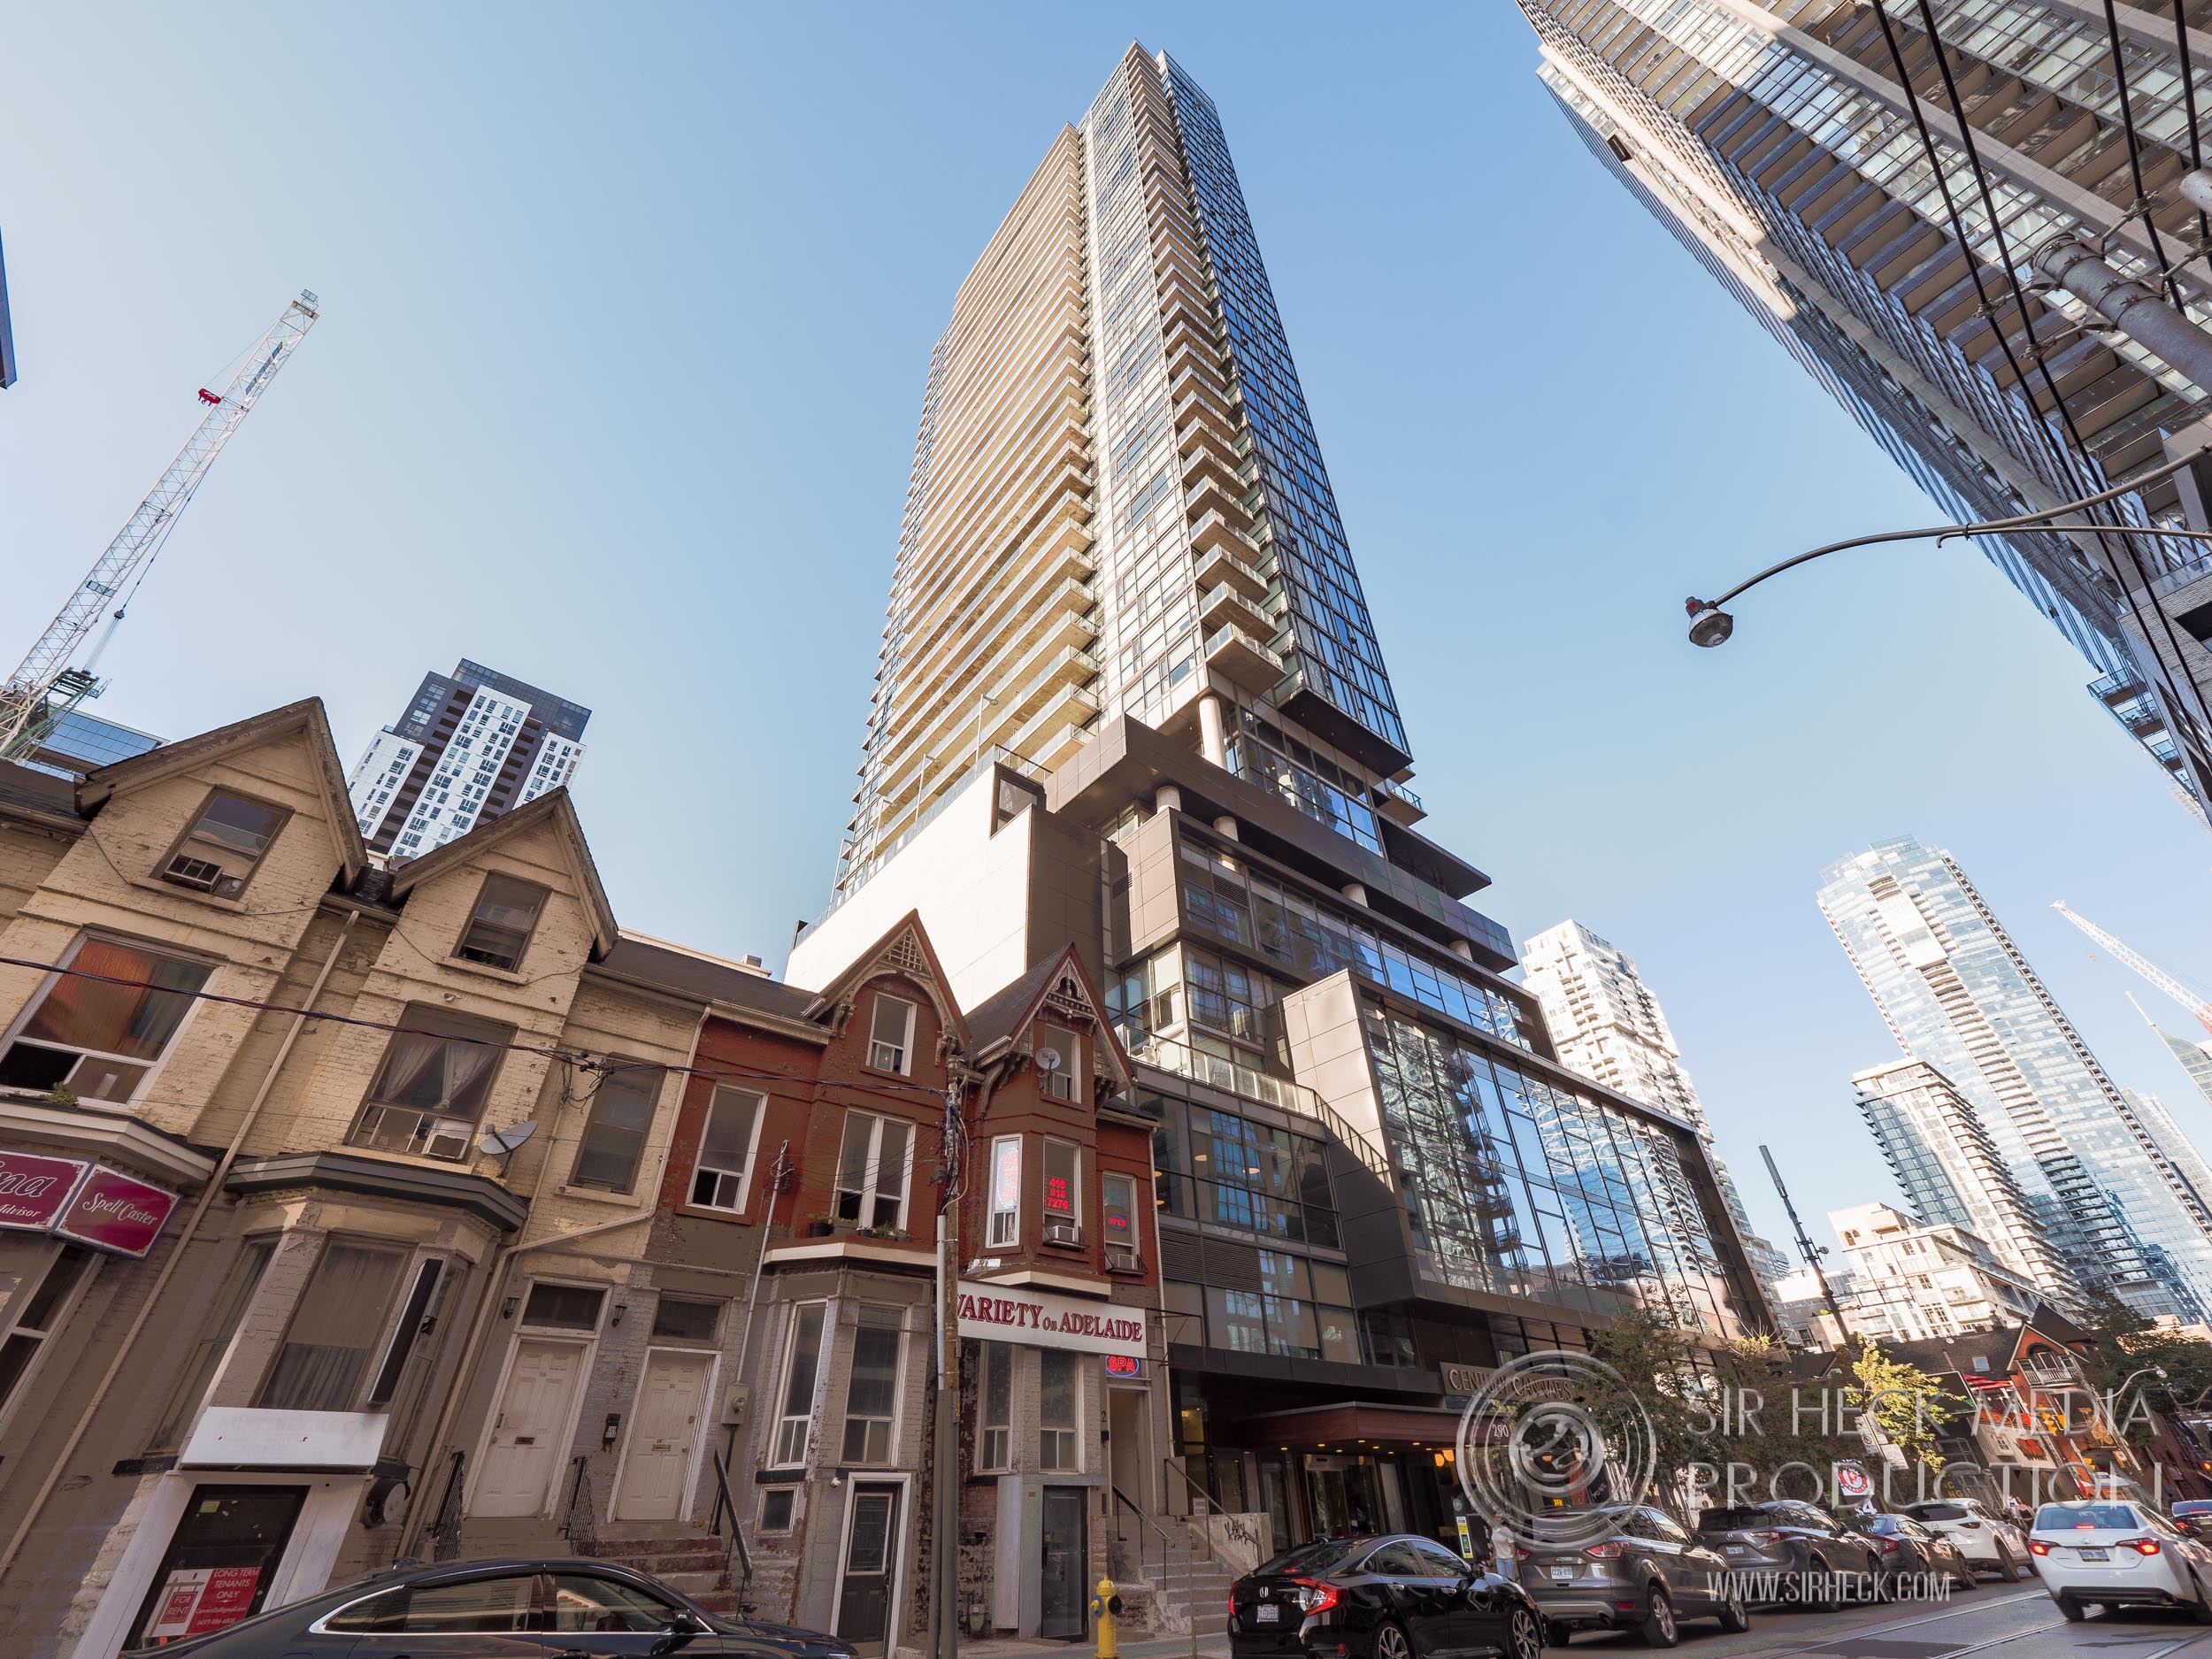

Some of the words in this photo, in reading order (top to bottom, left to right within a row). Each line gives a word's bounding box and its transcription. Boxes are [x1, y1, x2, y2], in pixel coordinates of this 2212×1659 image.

[82, 1193, 122, 1214] Spell
[118, 1203, 157, 1225] Caster
[1108, 1217, 1126, 1227] OPEN
[1058, 1311, 1143, 1342] ADELAIDE
[1109, 1356, 1135, 1371] SPA
[1492, 1423, 1509, 1438] 290
[214, 1579, 250, 1588] TENANTS
[174, 1595, 192, 1604] FOR
[217, 1590, 240, 1599] ONLY
[168, 1606, 190, 1615] RENT
